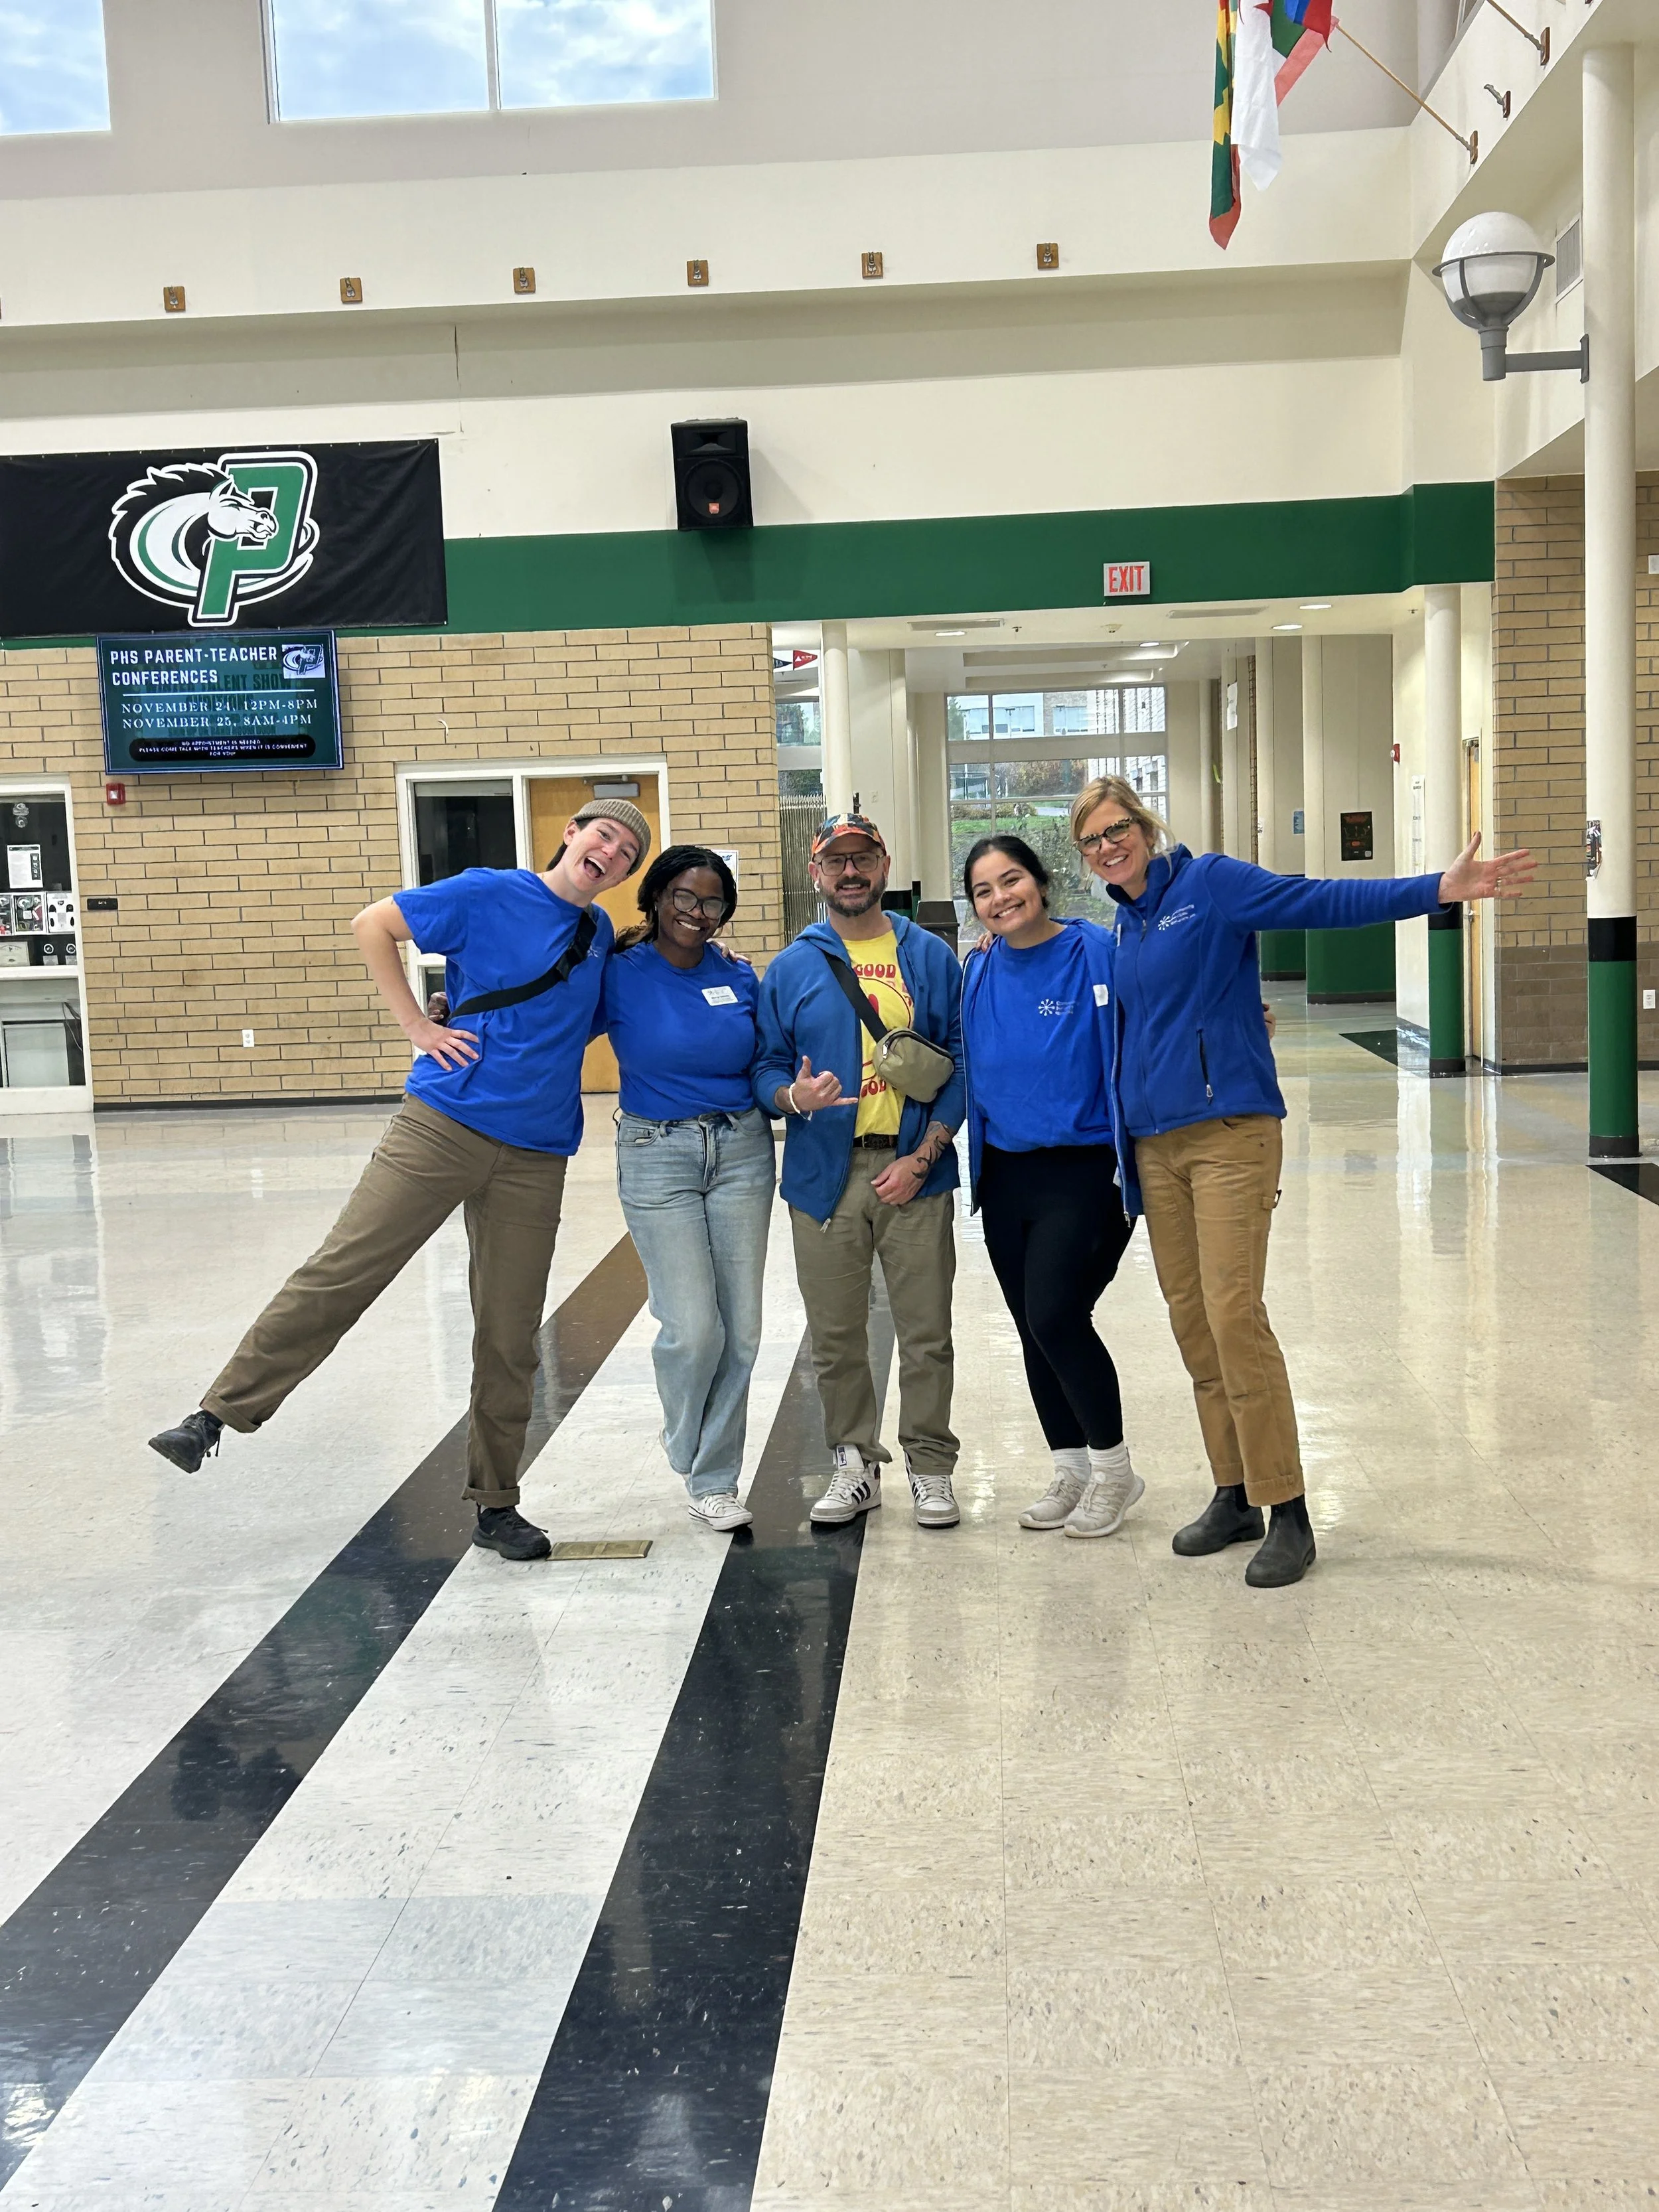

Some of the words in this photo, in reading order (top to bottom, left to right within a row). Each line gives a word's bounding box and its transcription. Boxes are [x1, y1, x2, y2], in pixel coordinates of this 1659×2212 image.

[1108, 565, 1145, 593] EXIT
[110, 650, 139, 665] PHS
[144, 646, 277, 664] PARENT-TEACHER
[111, 669, 218, 686] CONFERENCES
[121, 701, 208, 714] NOVEMBER
[244, 698, 318, 711] 12PM-8PM
[122, 716, 210, 729] NOVEMBER
[244, 714, 311, 726] 8AM-4PM
[853, 964, 896, 978] GOOD
